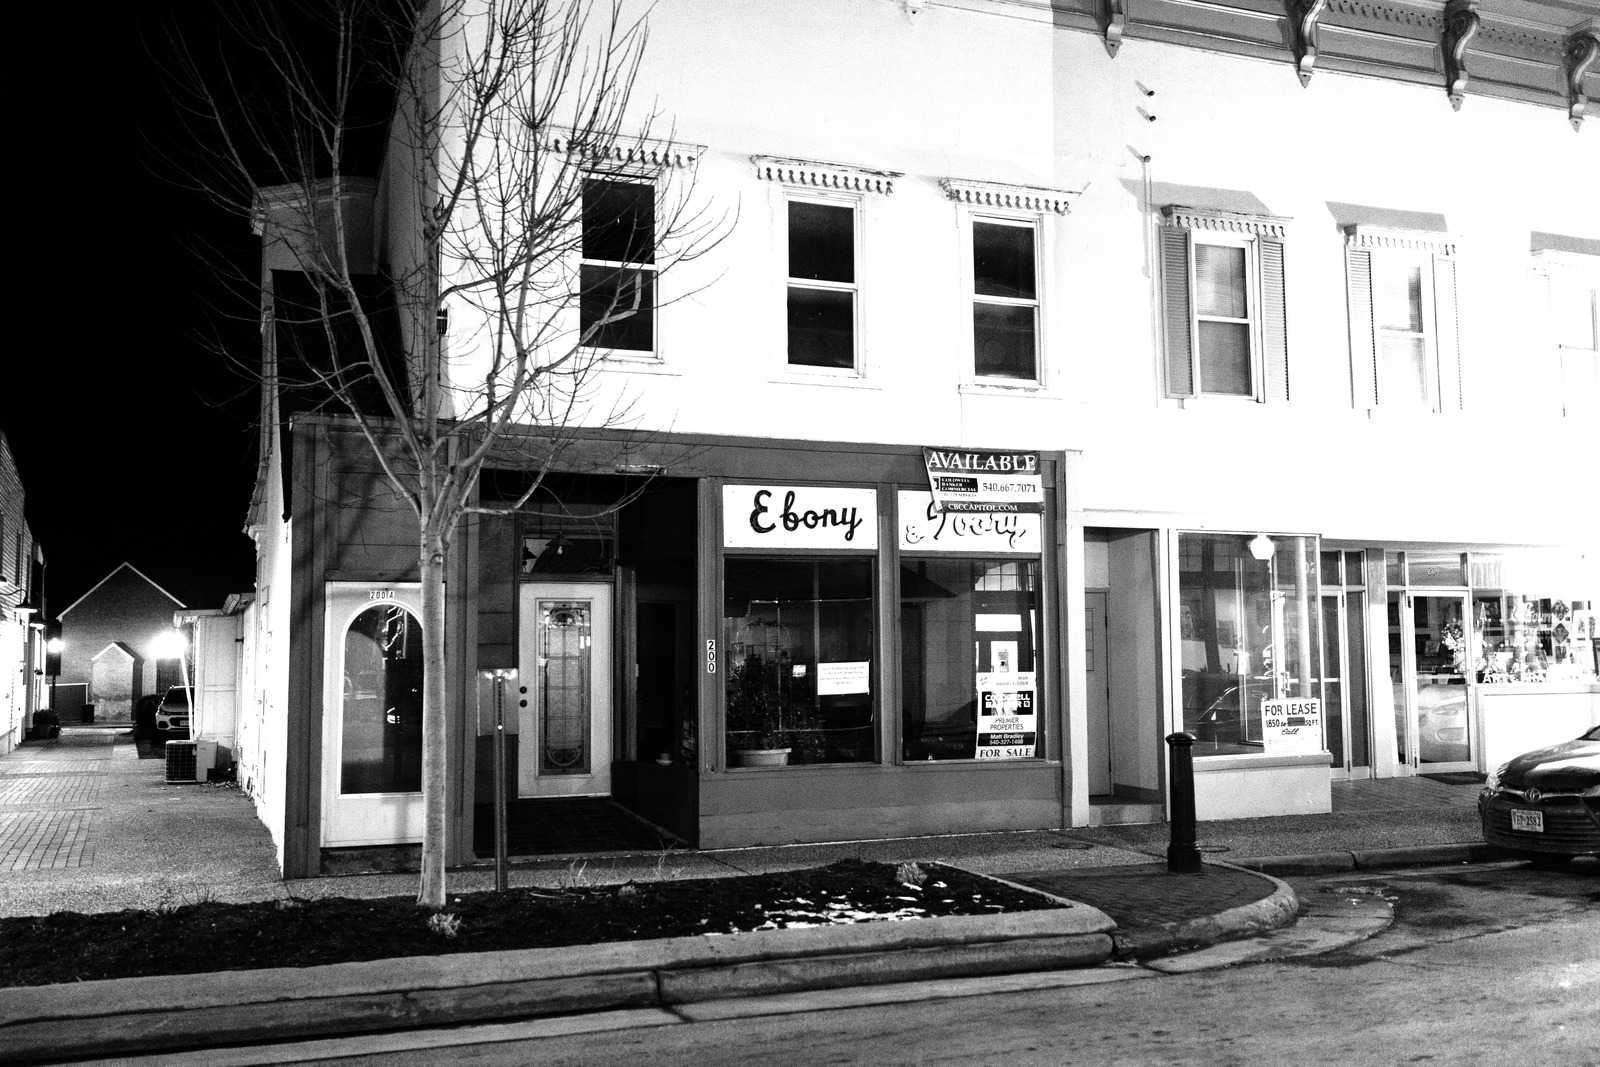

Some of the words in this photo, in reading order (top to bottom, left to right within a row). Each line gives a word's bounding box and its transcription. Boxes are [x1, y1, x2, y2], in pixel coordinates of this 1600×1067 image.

[928, 451, 1036, 471] AVAILABLE
[982, 482, 1037, 493] 540.667.7071
[947, 503, 1018, 512] CBCCAPITOL.COM
[749, 489, 863, 542] Ebony
[707, 640, 715, 673] 200
[1265, 705, 1283, 716] FOR
[1286, 703, 1317, 715] LEASE
[1281, 727, 1300, 735] Call
[980, 749, 1000, 757] FOR
[1006, 748, 1031, 756] SALE
